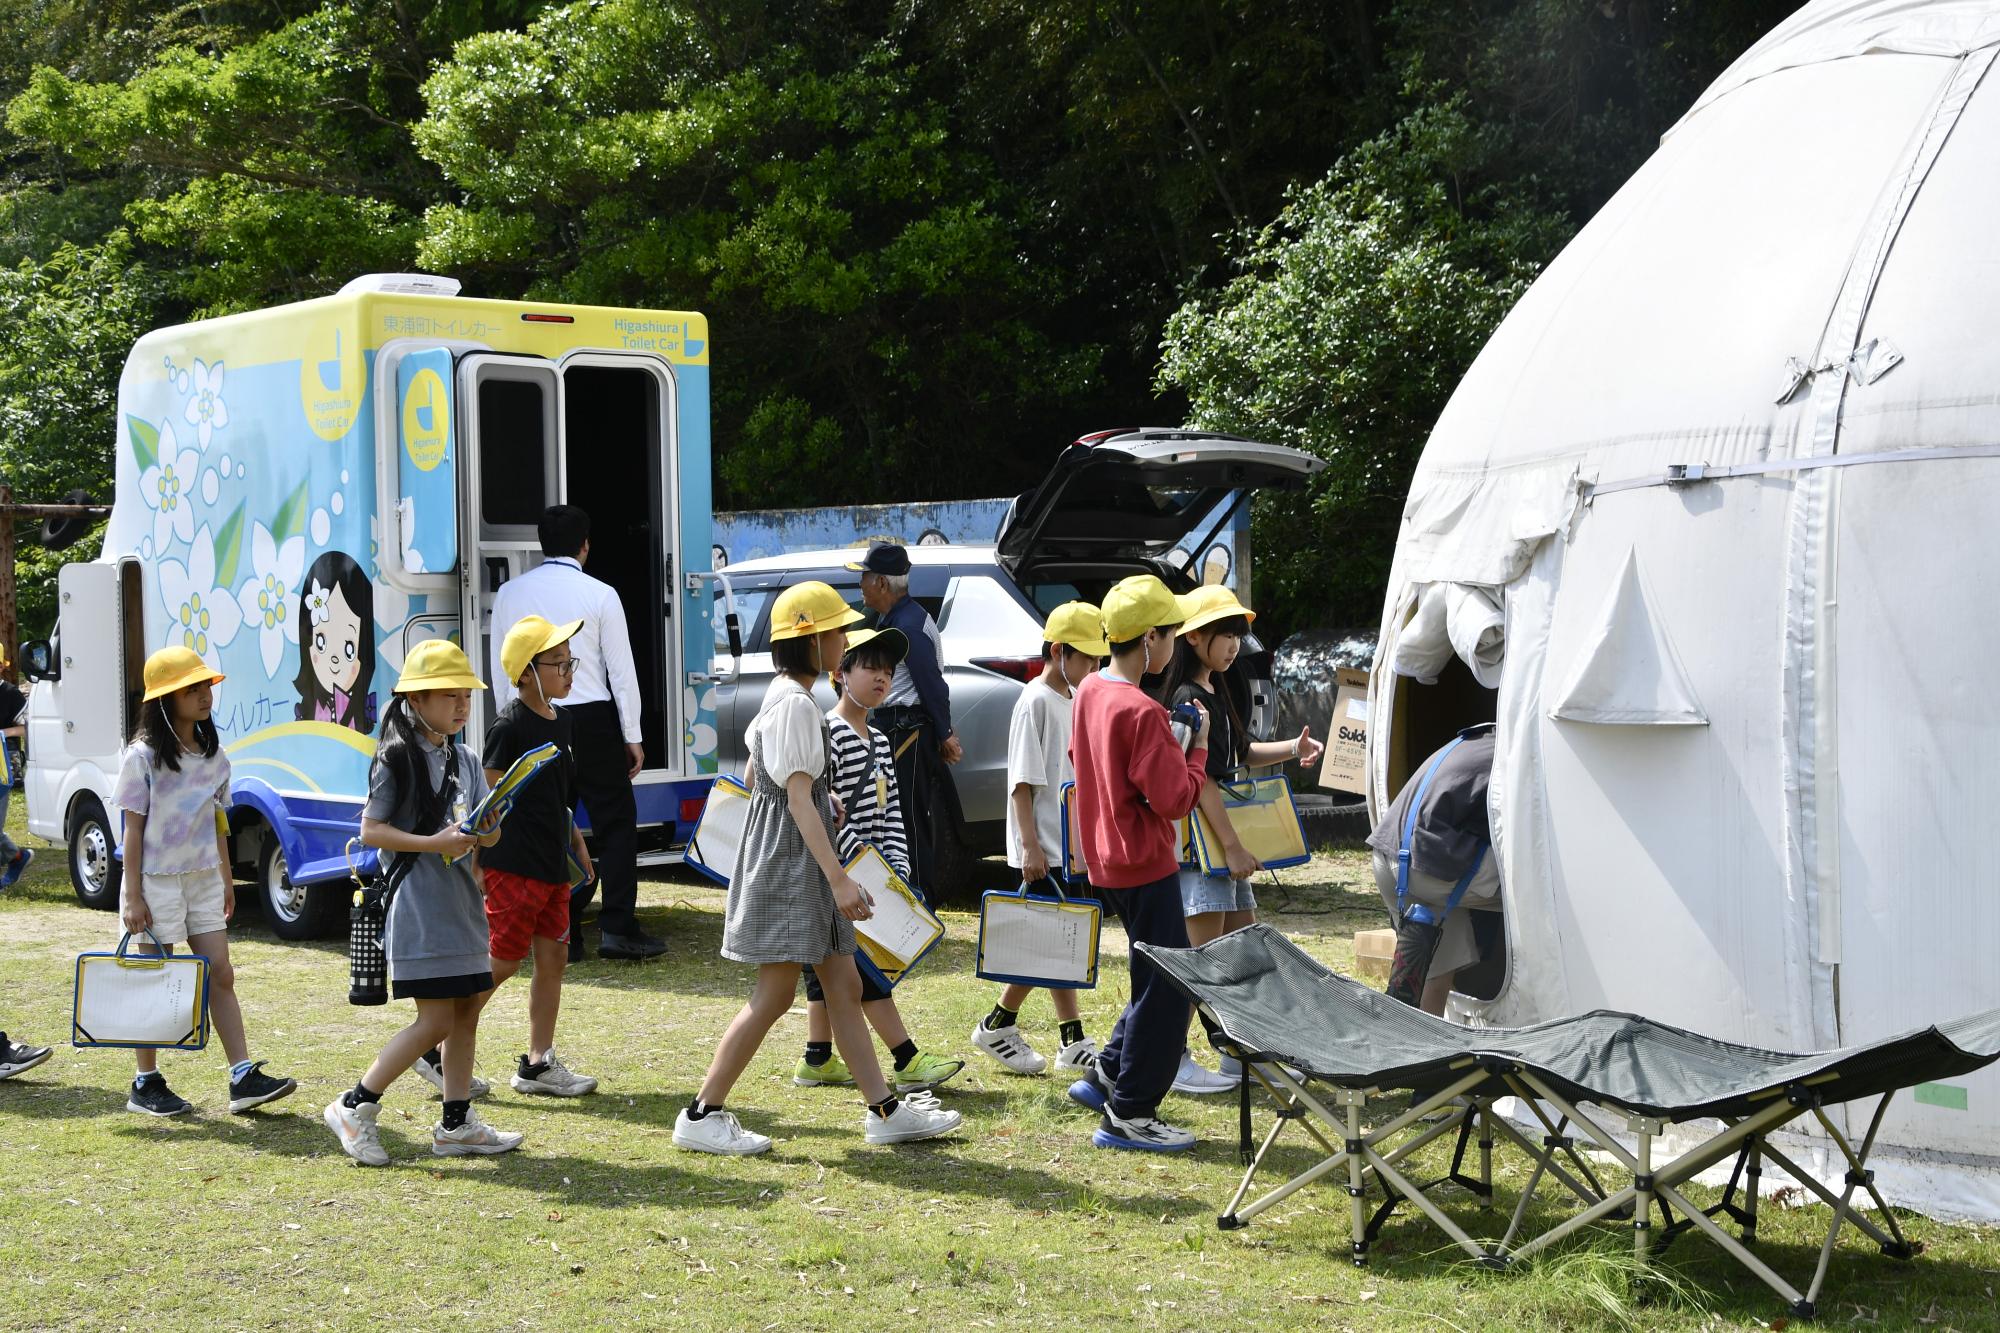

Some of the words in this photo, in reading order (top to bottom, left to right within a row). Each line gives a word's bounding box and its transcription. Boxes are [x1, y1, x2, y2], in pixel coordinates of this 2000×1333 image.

[383, 315, 504, 337] 東浦町トイレカー
[614, 319, 679, 335] Higashiura
[623, 336, 656, 349] Toilet
[659, 338, 679, 350] Car
